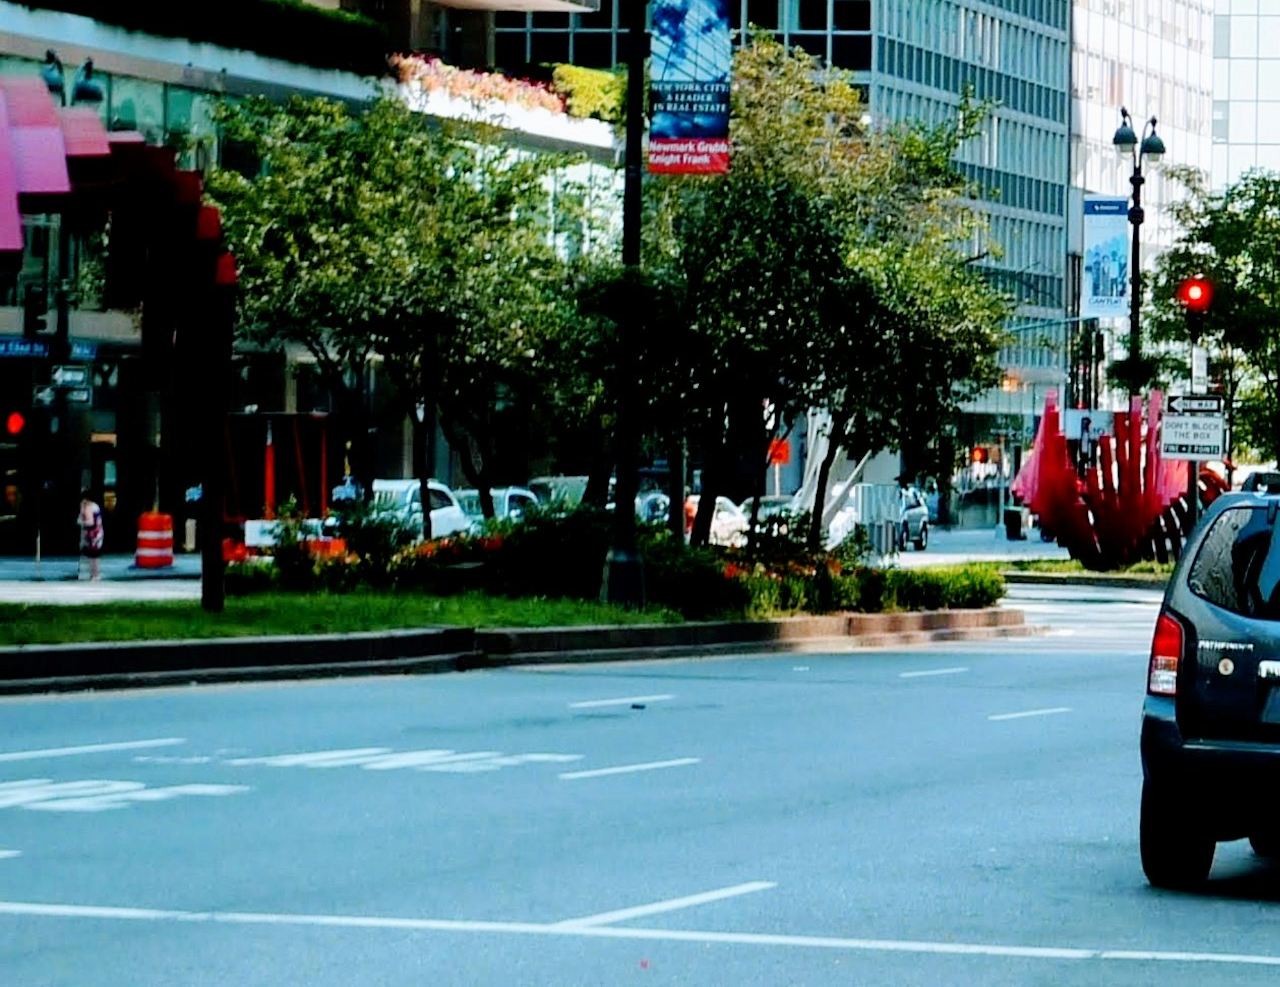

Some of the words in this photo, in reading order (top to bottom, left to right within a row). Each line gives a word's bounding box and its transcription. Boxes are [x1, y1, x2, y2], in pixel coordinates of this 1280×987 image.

[651, 83, 673, 91] NEW
[675, 83, 701, 92] YORK
[666, 94, 673, 102] A
[675, 94, 713, 102] LEADER
[653, 103, 665, 111] IN
[666, 103, 690, 112] REAL
[692, 104, 727, 112] ESTATE
[649, 141, 696, 152] Newmark
[697, 141, 728, 153] Grubb
[649, 152, 681, 166] Knight
[683, 153, 710, 164] Frank
[1165, 421, 1189, 430] DON'T
[1192, 422, 1219, 431] BLOCK
[1174, 432, 1190, 440] THE
[1193, 432, 1211, 440] BOX
